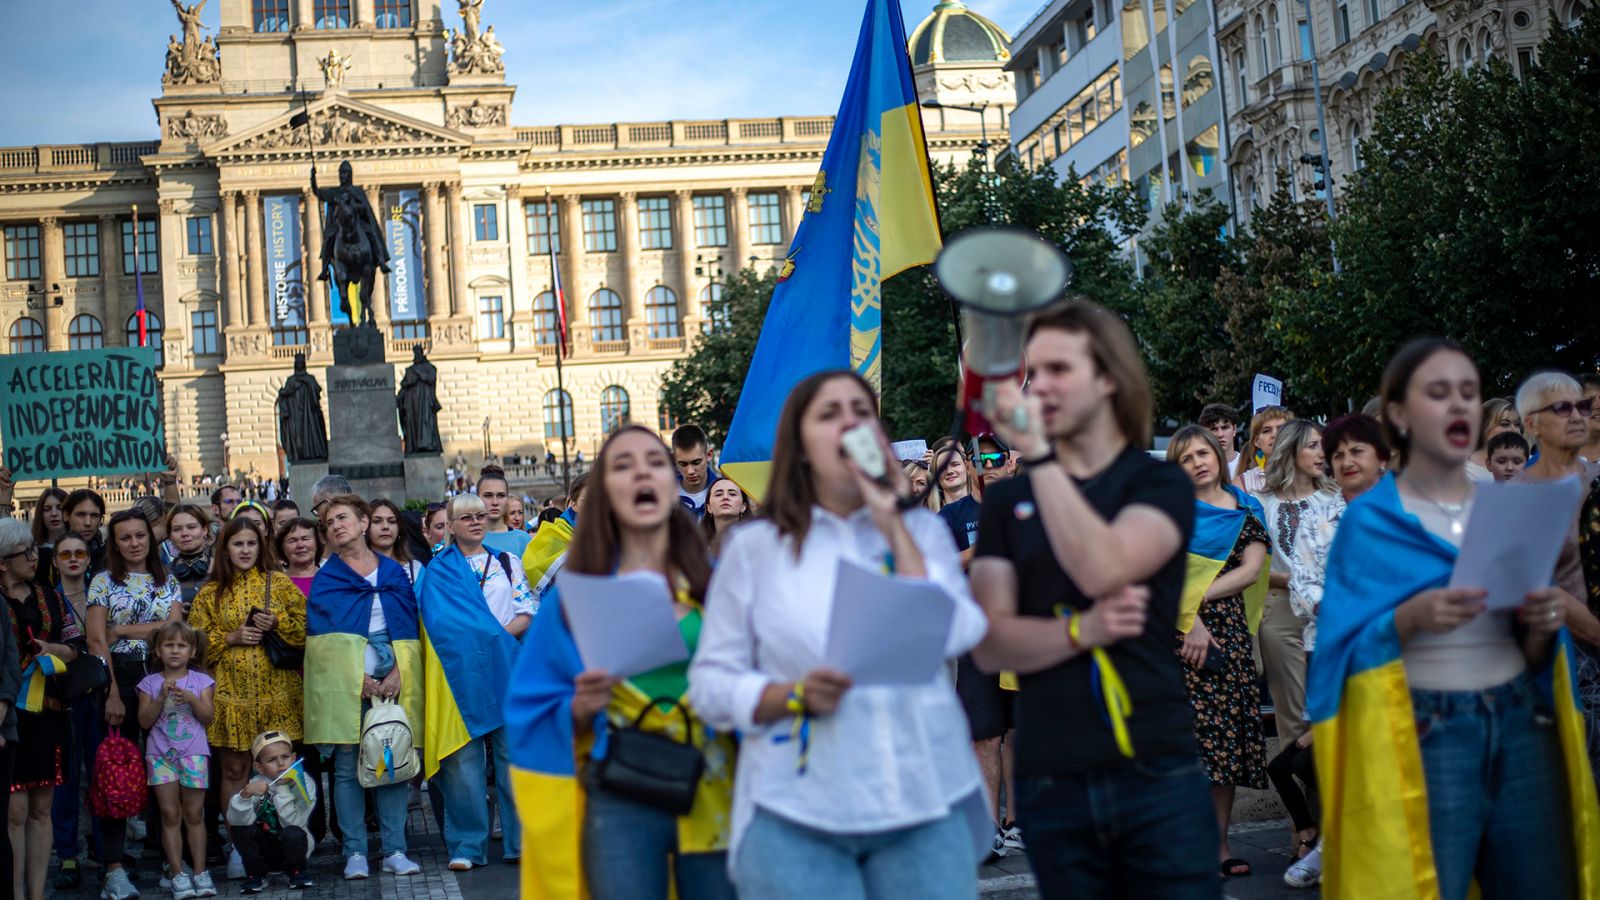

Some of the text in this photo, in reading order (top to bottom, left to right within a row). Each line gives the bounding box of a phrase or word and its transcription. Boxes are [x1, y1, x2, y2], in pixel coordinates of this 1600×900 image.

[391, 205, 405, 256] NATURE
[272, 203, 288, 320] HISTORIE HISTORY
[7, 354, 155, 398] ACCELERATED
[8, 393, 162, 440] INDEPENDENCY
[58, 431, 95, 444] AND
[7, 433, 167, 474] DECOLONISATION
